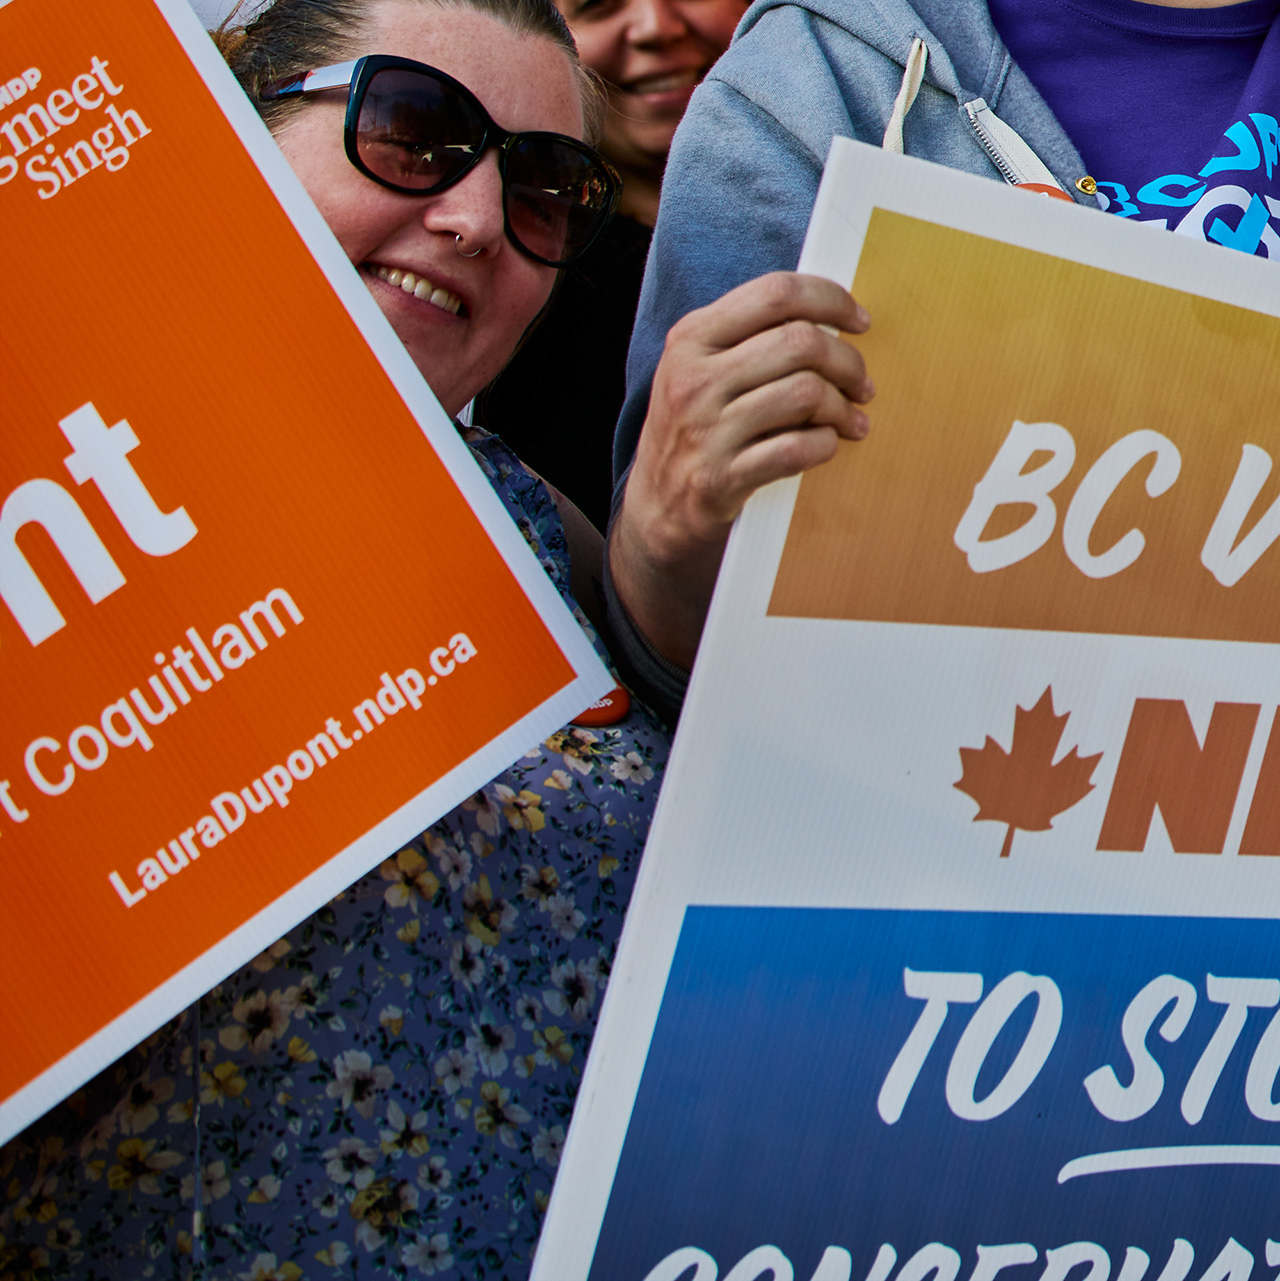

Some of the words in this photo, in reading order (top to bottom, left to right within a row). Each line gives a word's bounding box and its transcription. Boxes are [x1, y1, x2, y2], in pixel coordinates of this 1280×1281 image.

[25, 103, 152, 200] Singh
[953, 420, 1183, 580] BC
[24, 588, 304, 796] Coquitlam
[108, 632, 478, 908] LauraDupont.ndp.ca
[877, 967, 1064, 1125] TO
